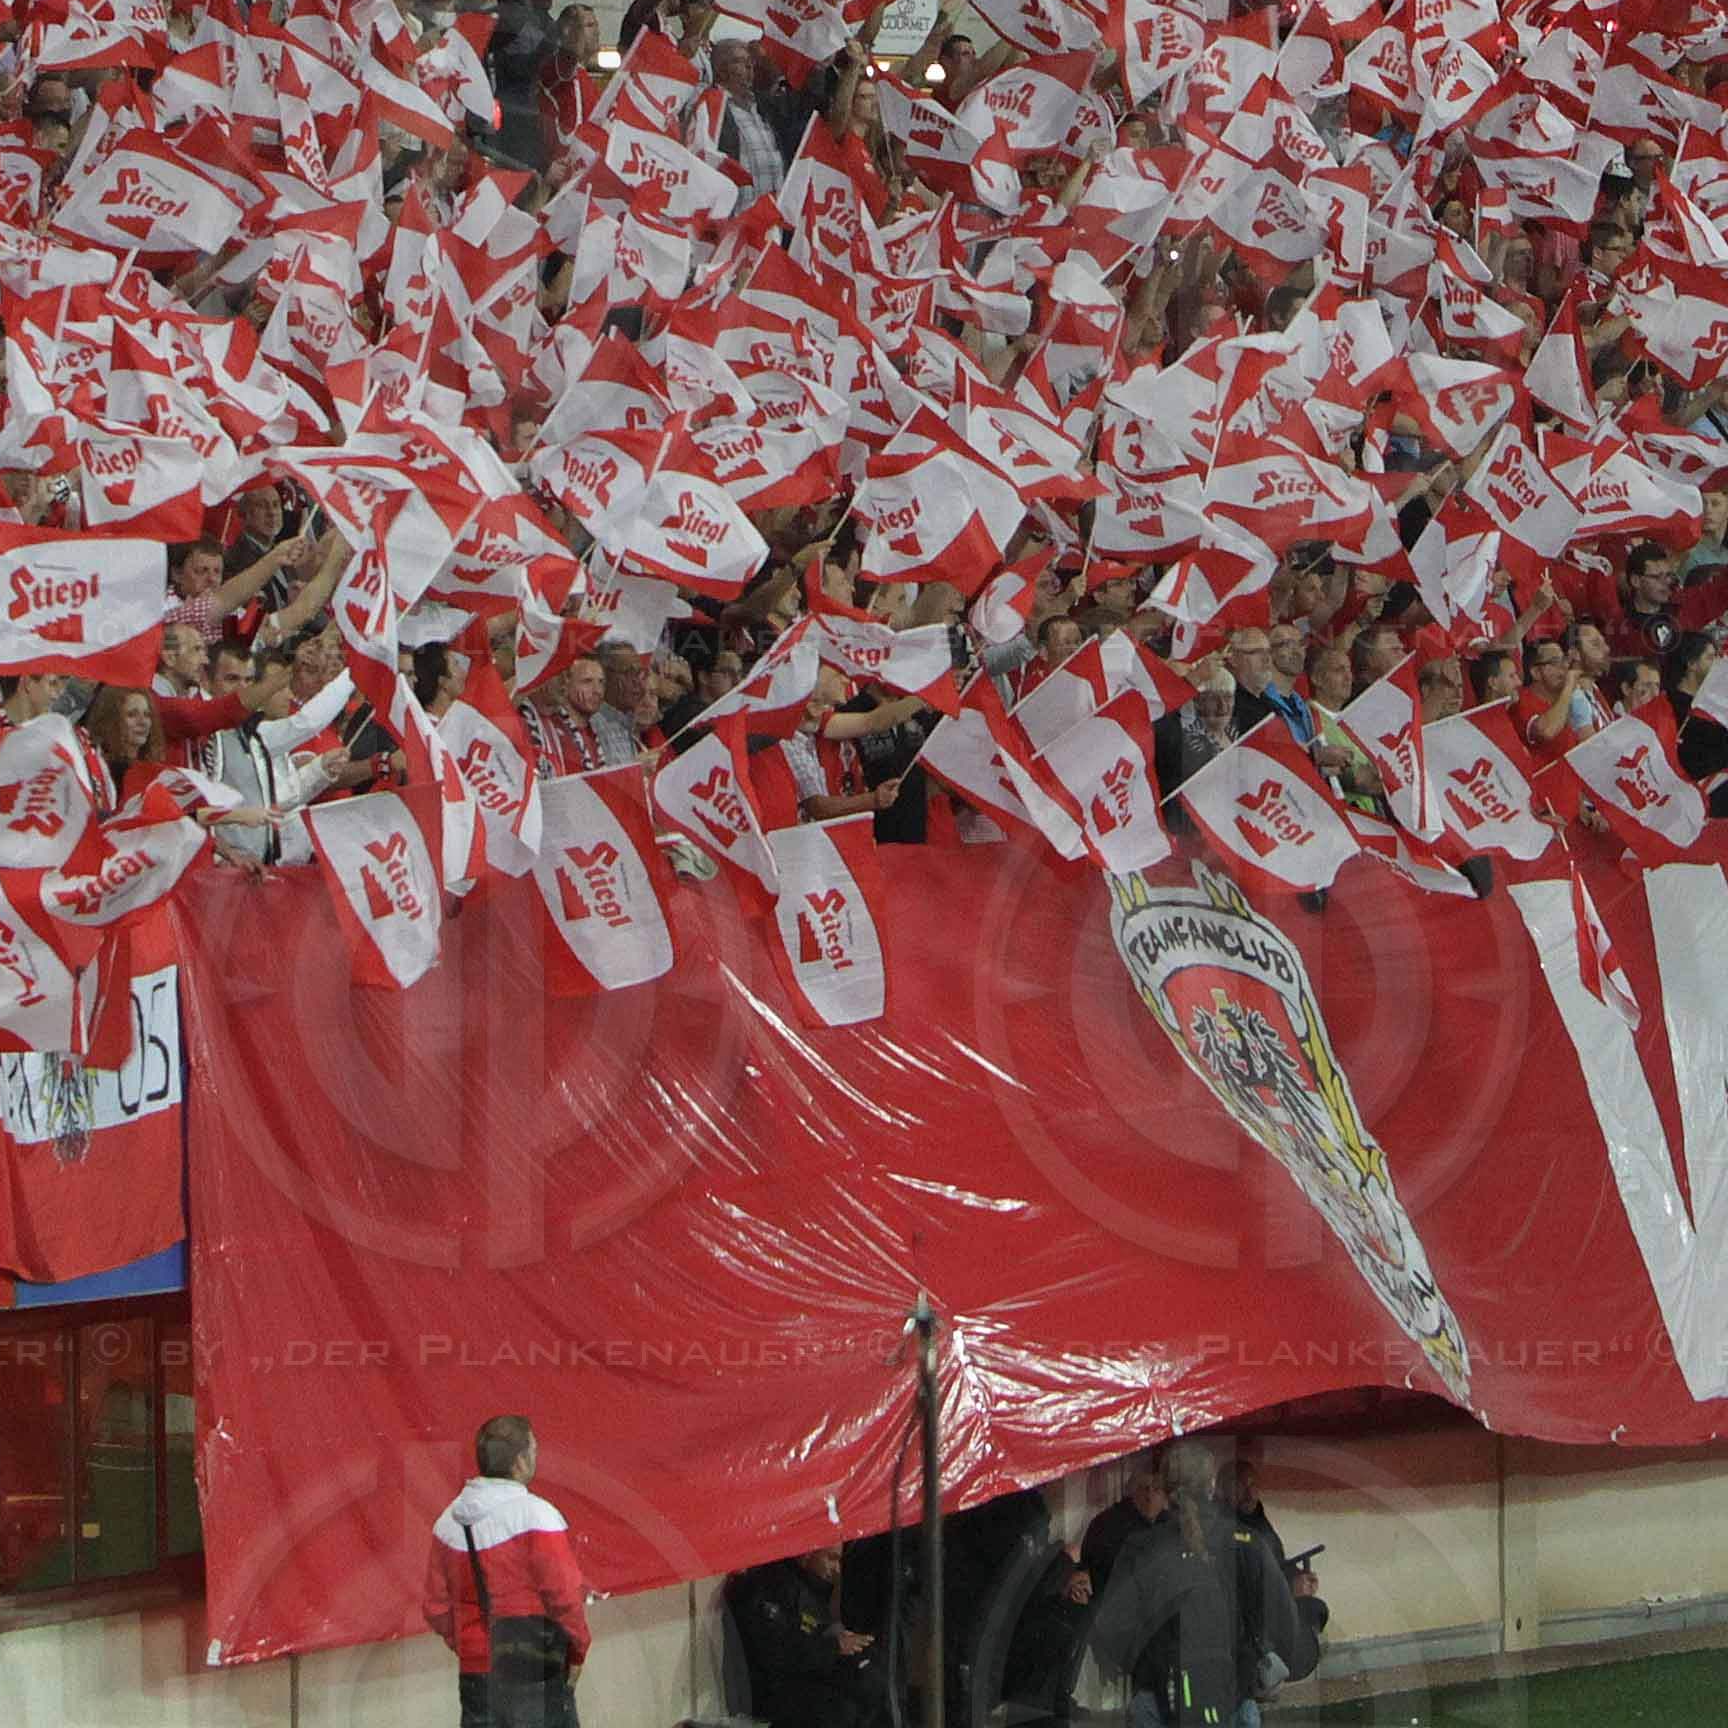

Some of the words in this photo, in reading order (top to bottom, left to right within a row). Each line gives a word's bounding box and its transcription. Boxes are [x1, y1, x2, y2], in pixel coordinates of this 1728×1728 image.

[1272, 115, 1329, 163] Stiegl
[100, 167, 190, 221] Stiegl
[1490, 444, 1543, 511] Stiegl
[662, 490, 730, 543] Stiegl
[8, 571, 100, 620] Stiegl
[458, 736, 520, 818] Stiegl
[1448, 757, 1517, 826] Stiegl
[1235, 777, 1316, 848] Stiegl
[364, 830, 424, 924] Stiegl
[564, 840, 634, 930] Stiegl
[804, 886, 853, 971] Stiegl
